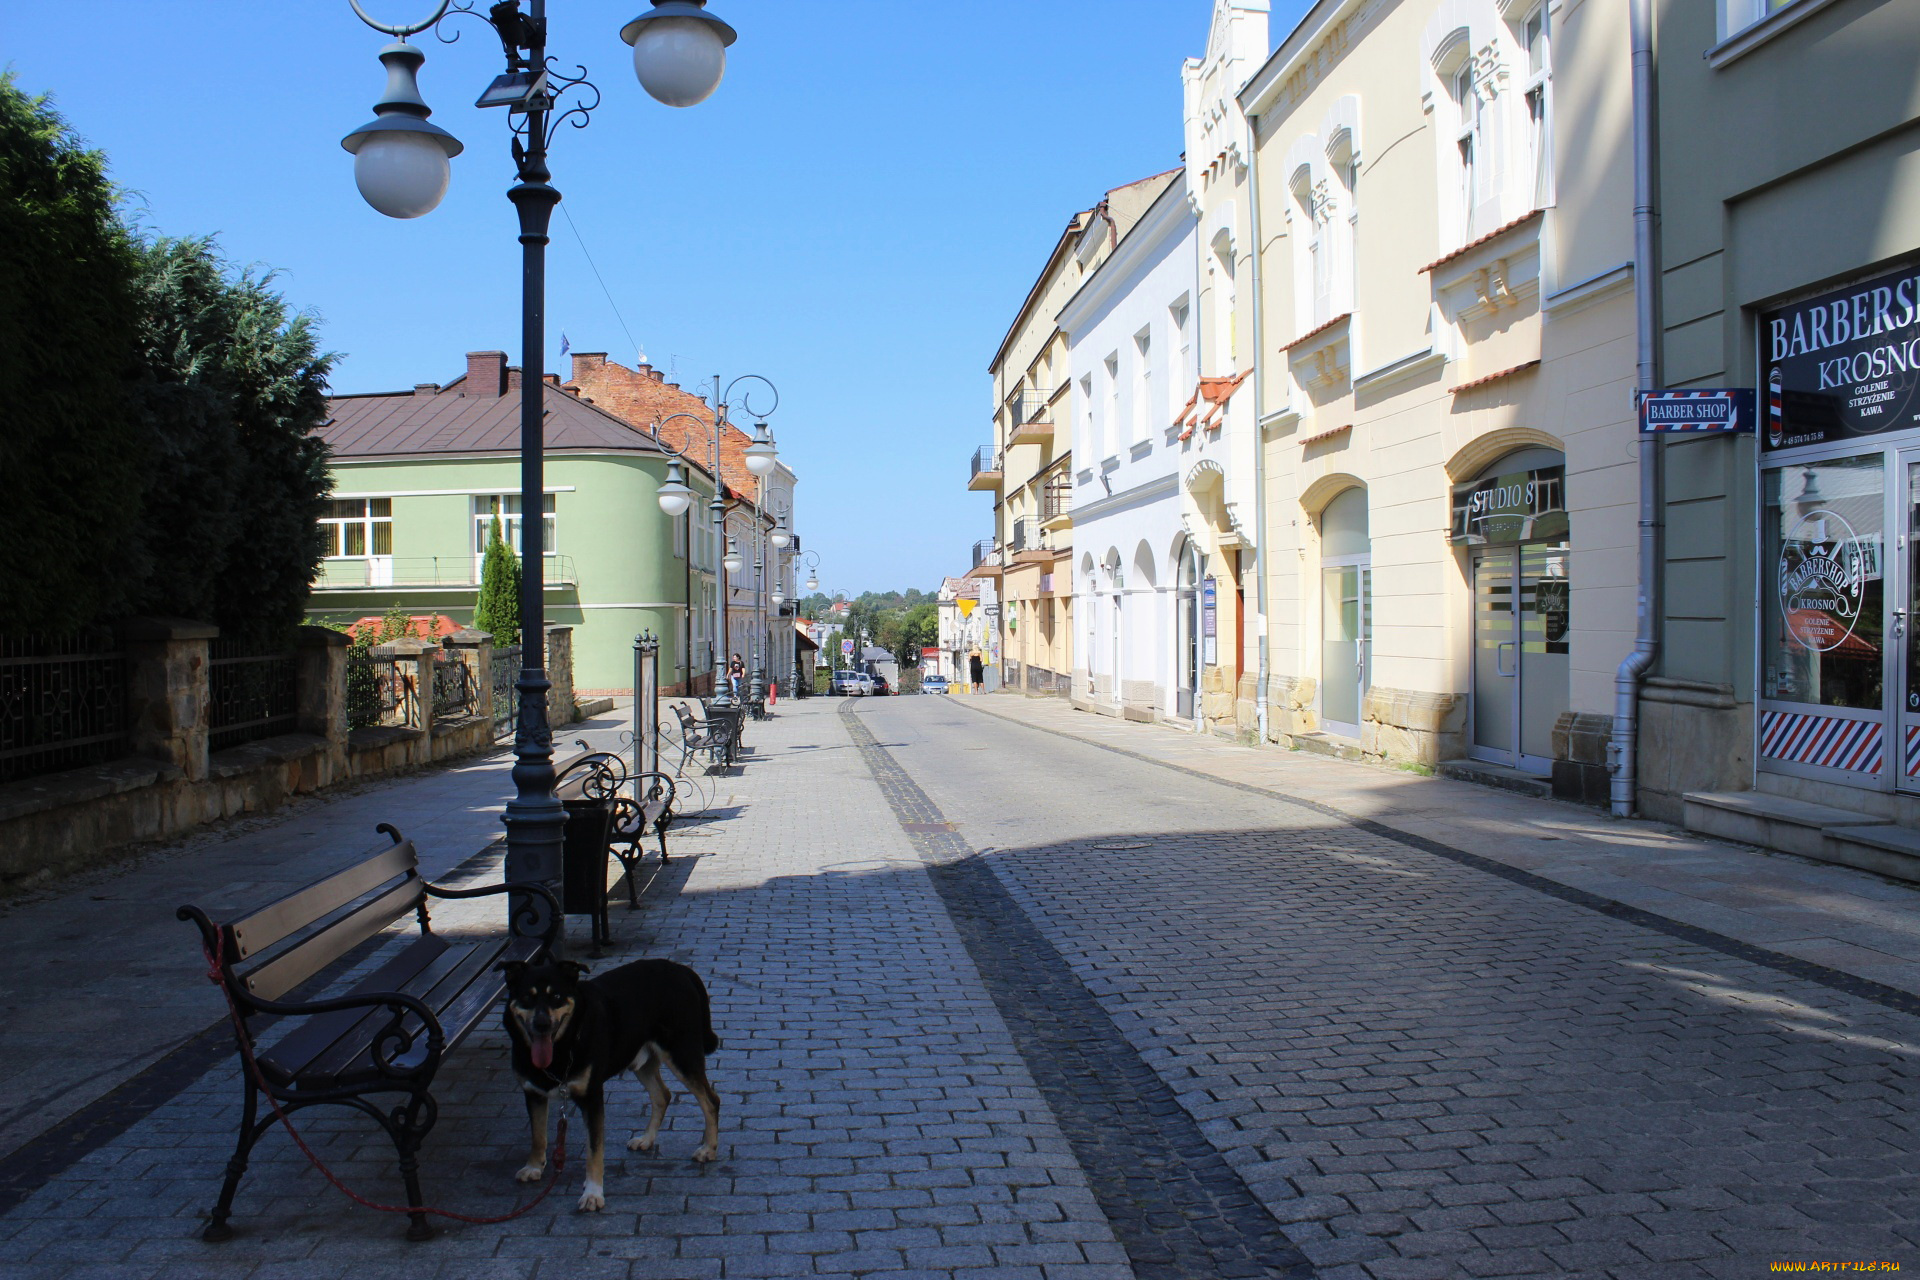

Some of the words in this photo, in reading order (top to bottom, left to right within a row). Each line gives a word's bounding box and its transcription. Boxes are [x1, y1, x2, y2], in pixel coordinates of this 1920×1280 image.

[1770, 277, 1920, 362] BARBERS
[1855, 380, 1889, 396] GOLENIE
[1849, 390, 1896, 408] STRZYŻENIE
[1651, 404, 1695, 419] BARBER
[1696, 403, 1727, 418] SHOP
[1860, 405, 1883, 417] KAWA
[1472, 484, 1522, 513] STUDIO
[1525, 481, 1534, 505] 8
[1789, 558, 1849, 592] BARBERSHOP
[1800, 598, 1836, 610] KROSNO
[1804, 618, 1830, 626] GOLENIE
